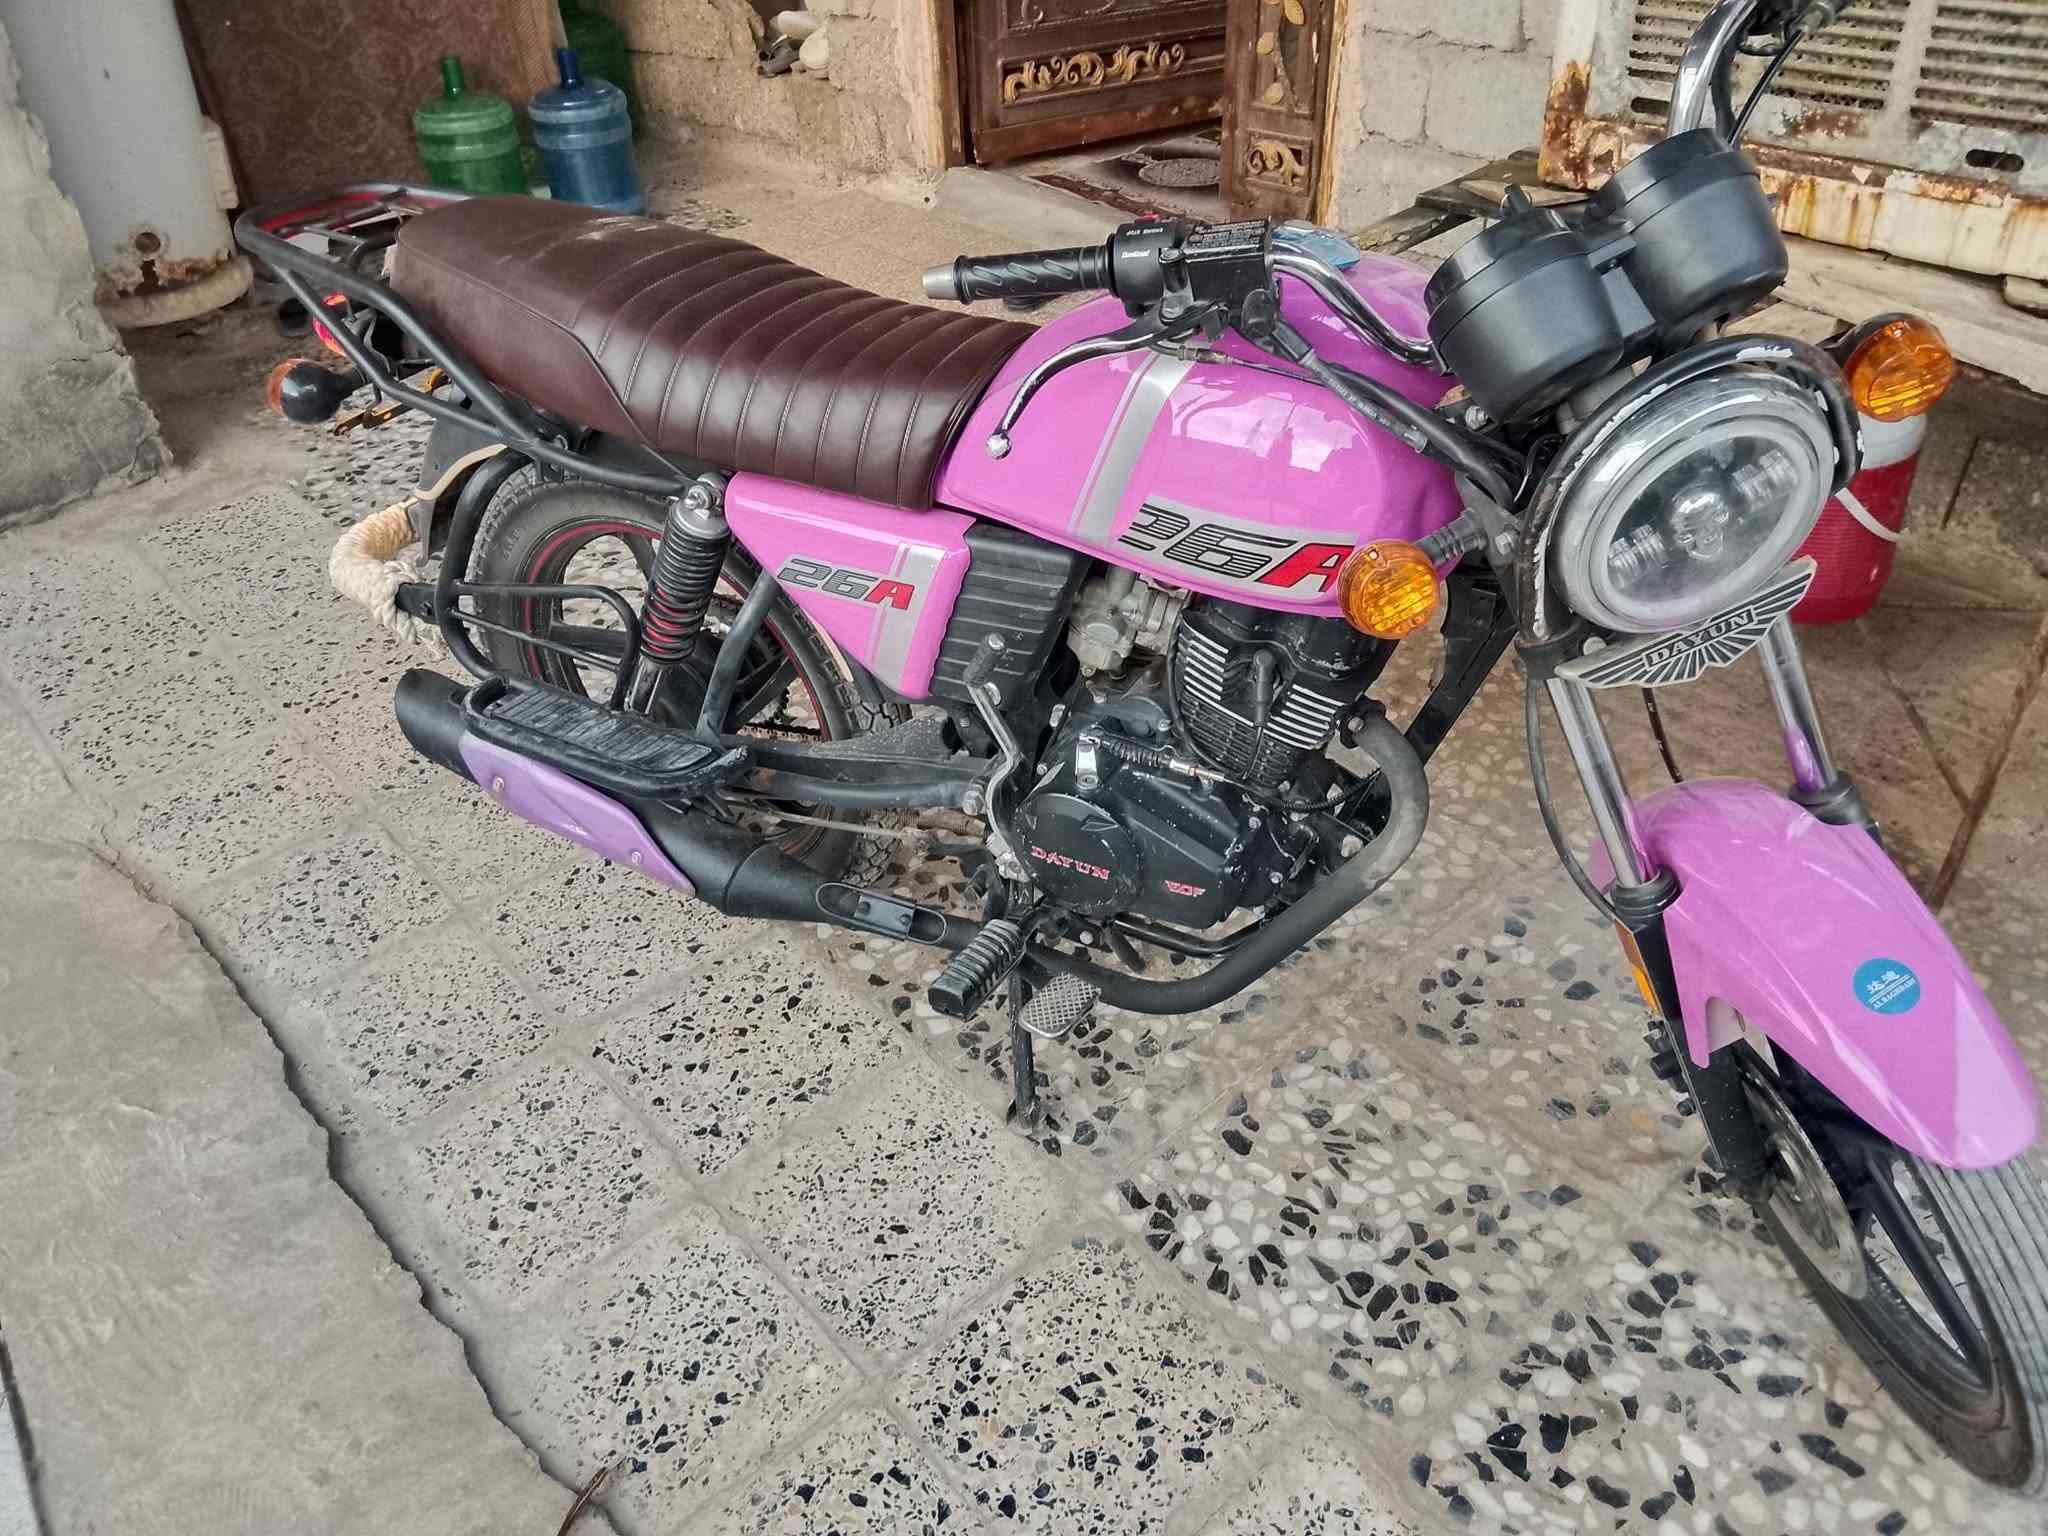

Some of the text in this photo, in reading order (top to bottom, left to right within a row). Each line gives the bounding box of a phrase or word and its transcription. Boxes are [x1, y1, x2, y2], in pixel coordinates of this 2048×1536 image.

[776, 558, 916, 611] 26A
[1649, 610, 1751, 665] DAYUN
[1031, 845, 1110, 881] DAYUN
